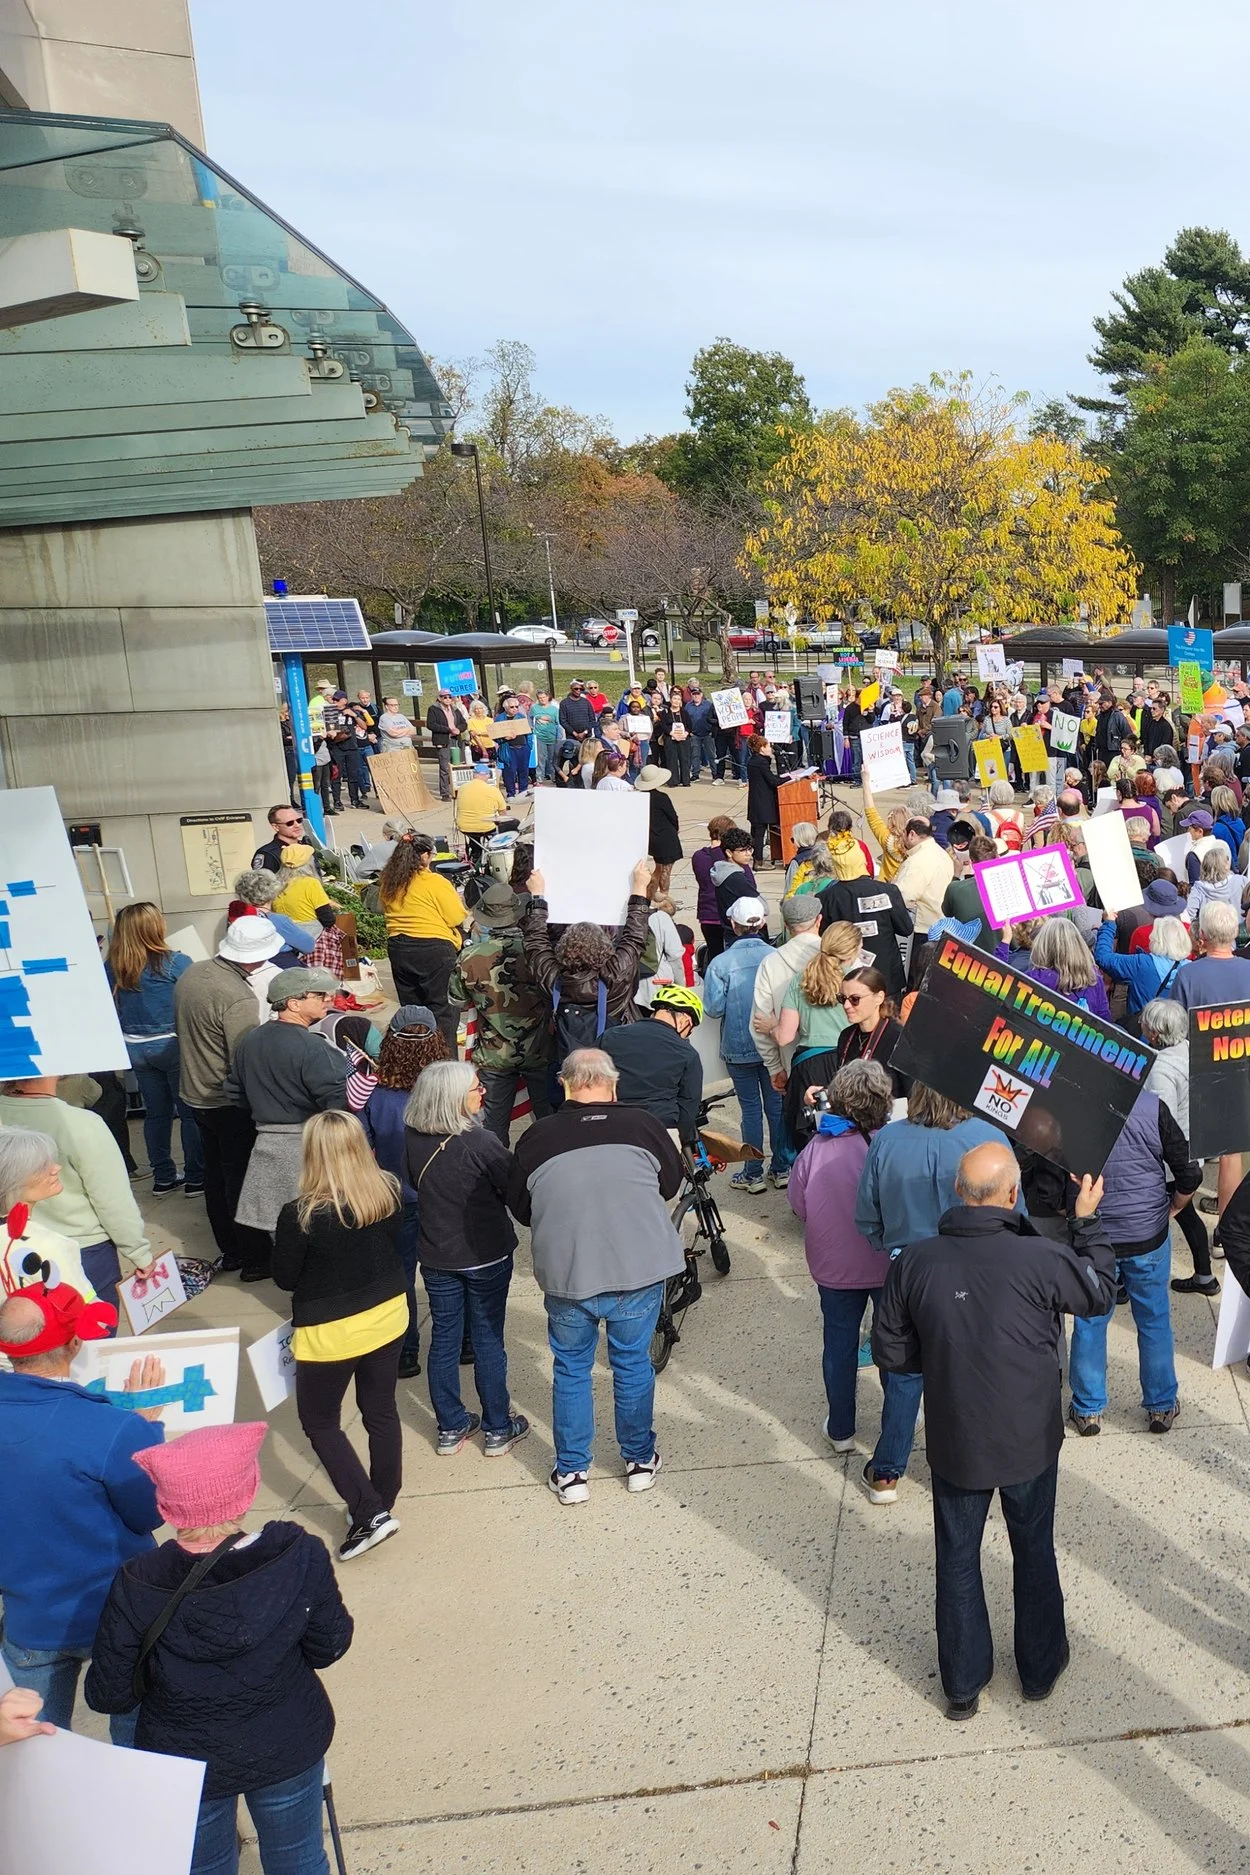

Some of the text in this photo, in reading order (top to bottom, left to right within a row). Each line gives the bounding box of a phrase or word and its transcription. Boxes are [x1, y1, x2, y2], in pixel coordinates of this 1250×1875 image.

[603, 629, 618, 637] STOP
[449, 683, 473, 693] CURES
[721, 711, 748, 724] PEOPLE
[1055, 714, 1078, 733] NO
[866, 727, 899, 744] SCIENCE
[867, 745, 902, 761] WISDOM
[938, 940, 1148, 1081] Equal Treatment
[982, 1016, 1061, 1089] For ALL
[985, 1103, 1009, 1121] KINGS
[988, 1093, 1013, 1114] NO
[278, 1333, 293, 1351] IC
